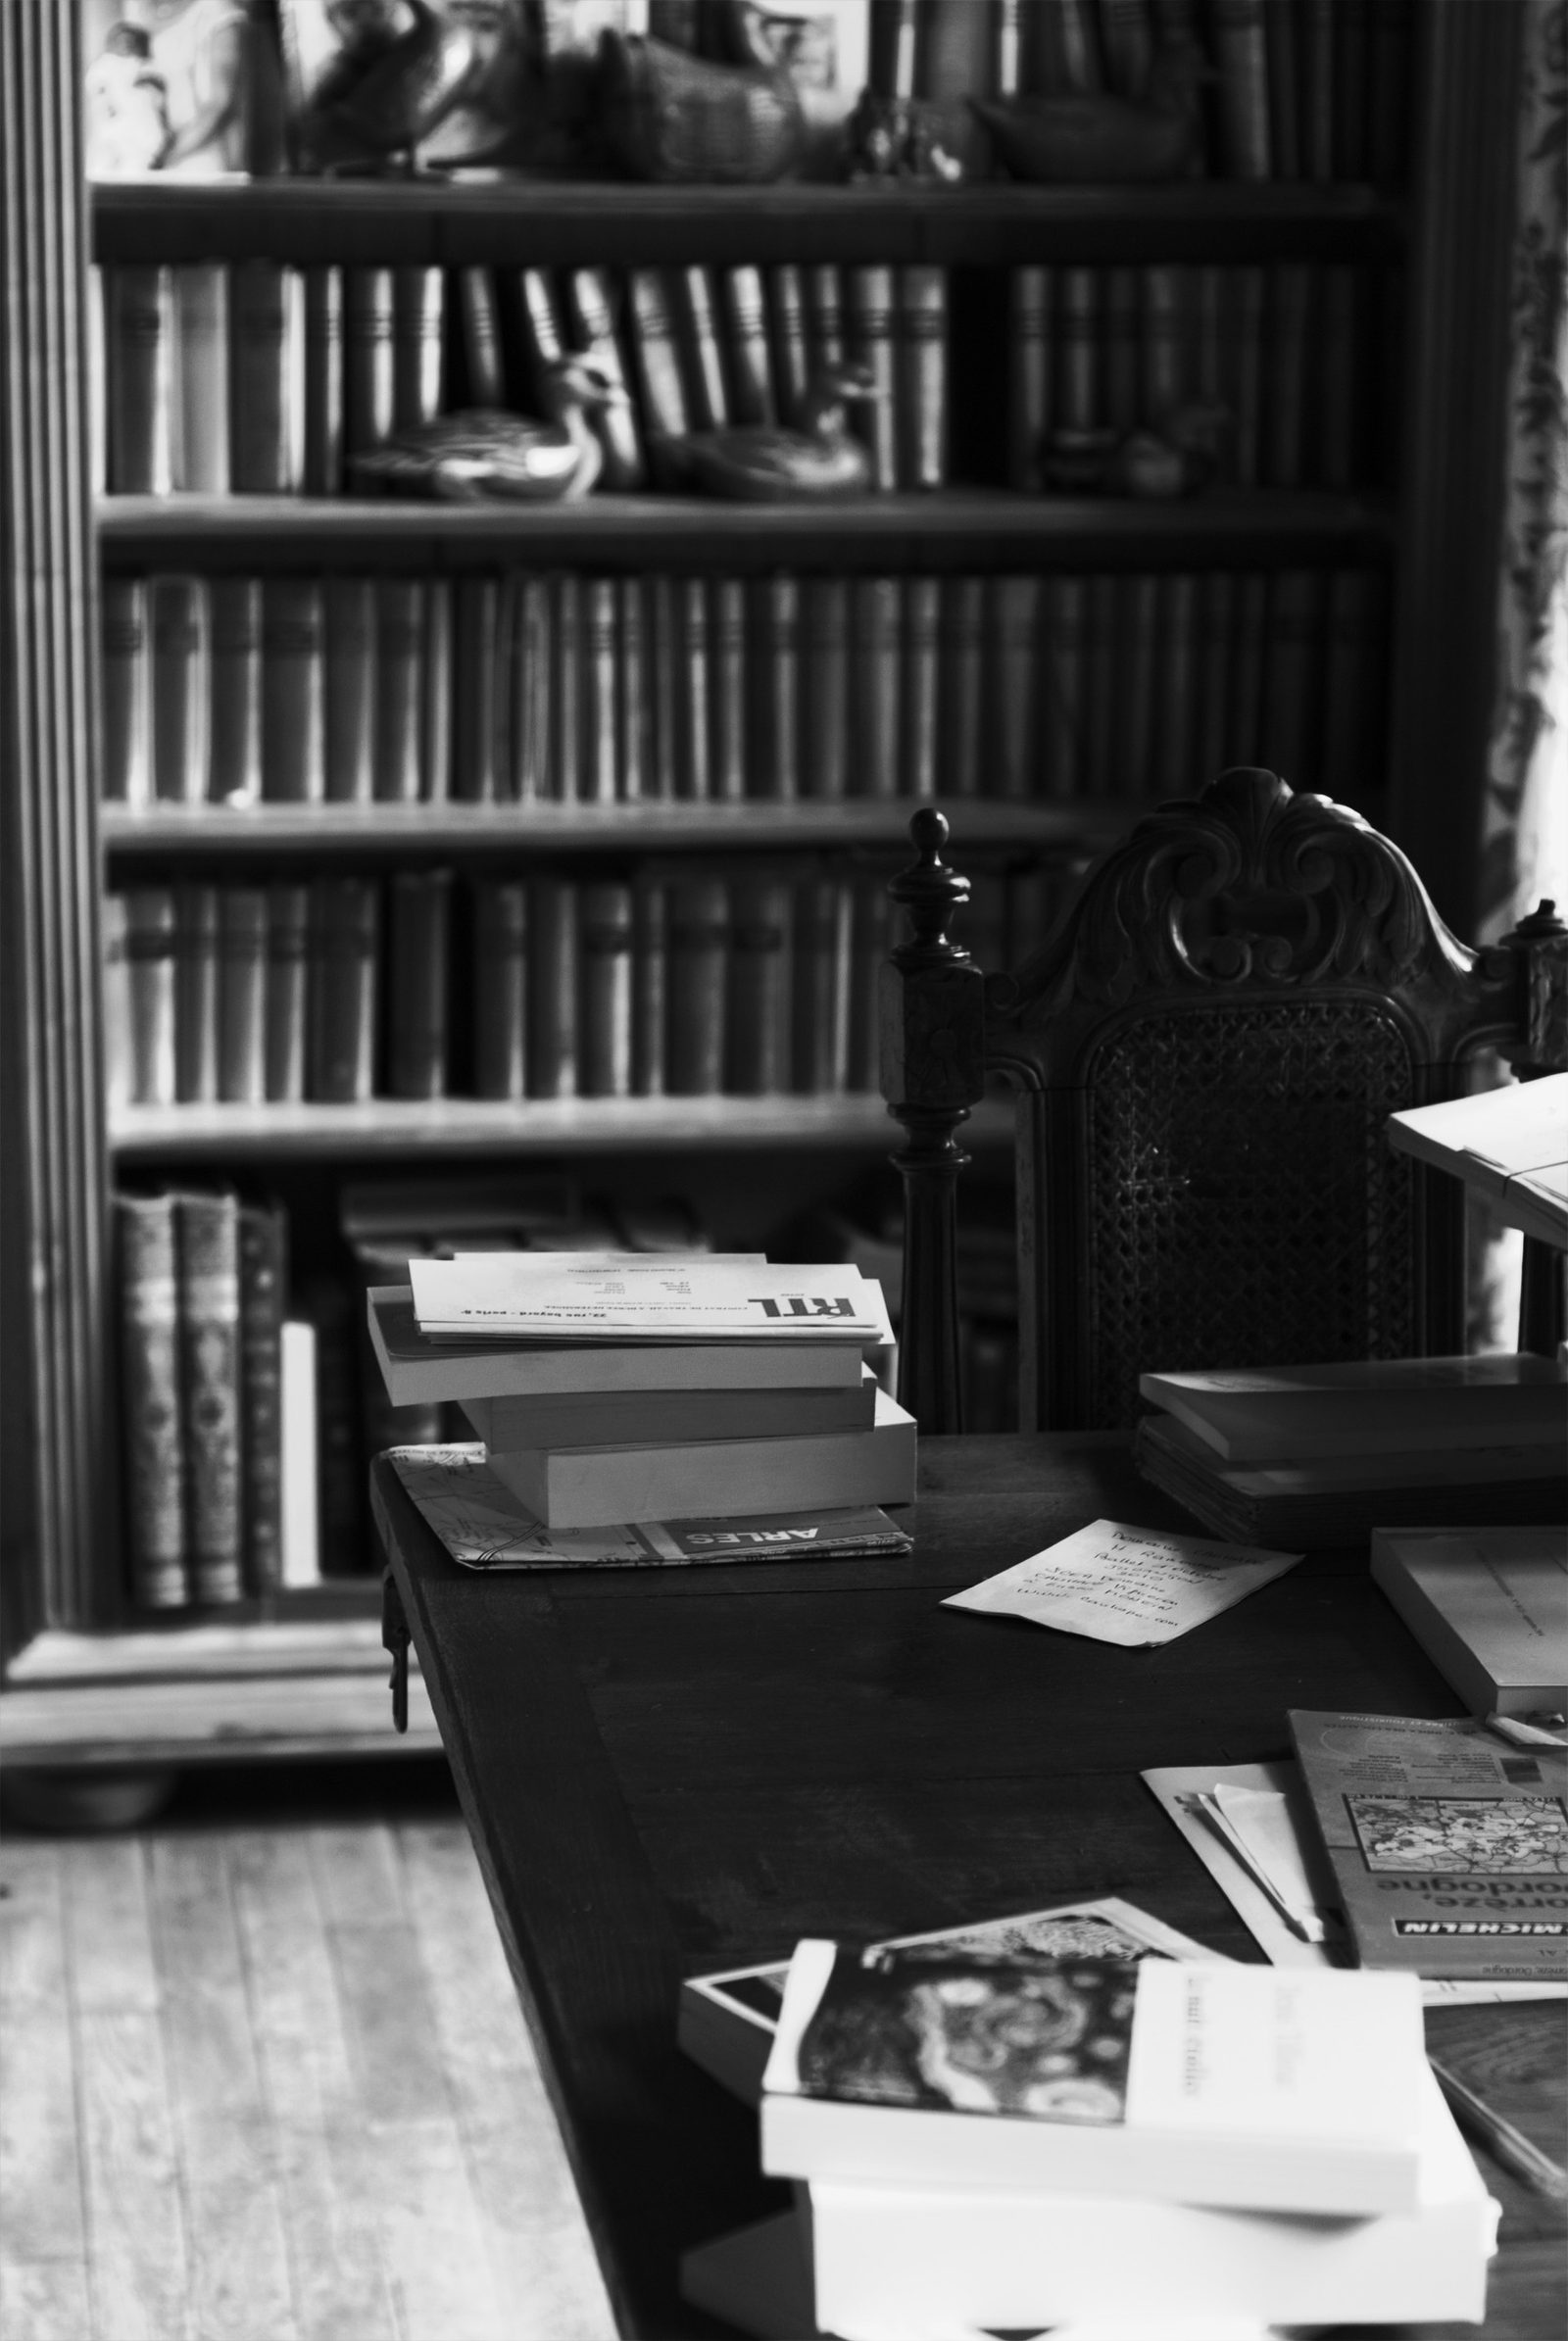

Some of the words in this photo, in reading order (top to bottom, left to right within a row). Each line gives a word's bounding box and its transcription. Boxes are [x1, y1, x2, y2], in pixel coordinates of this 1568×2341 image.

[747, 1296, 857, 1319] RTL
[685, 1527, 819, 1545] ARLES
[1377, 1878, 1568, 1897] ordogne
[1423, 1895, 1568, 1913] orrèze,
[1403, 1922, 1563, 1934] MICHELIN
